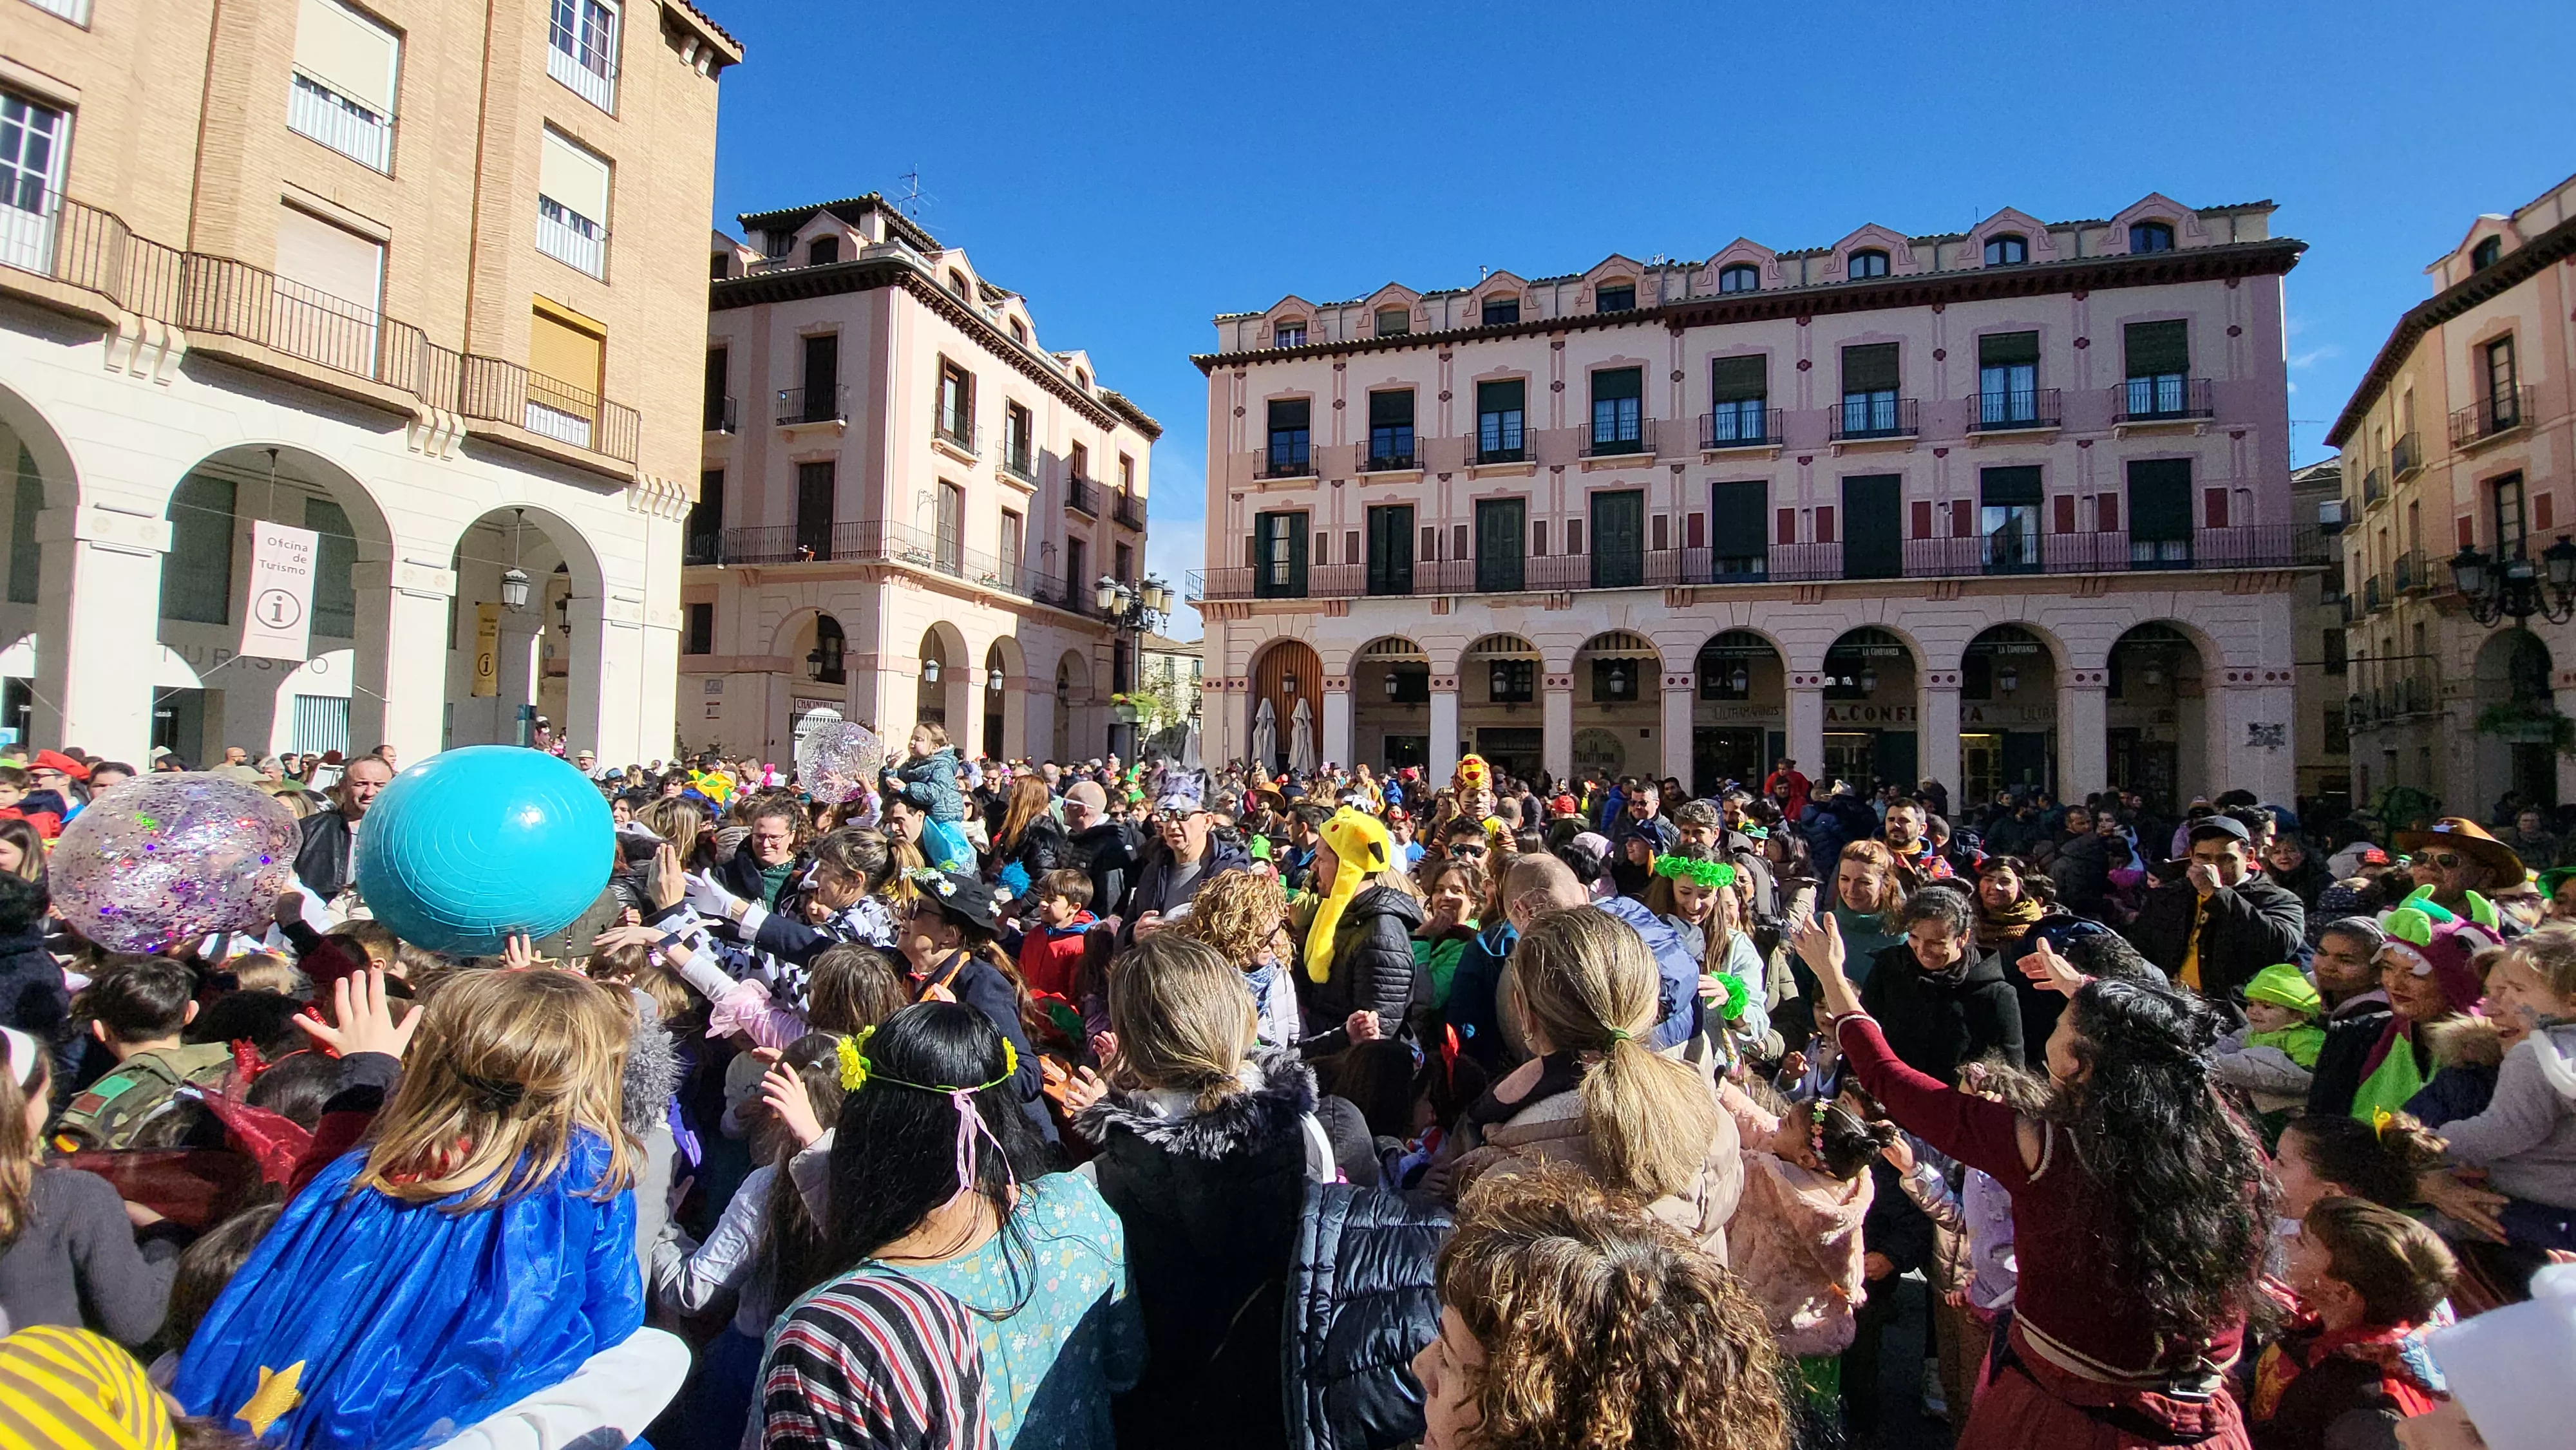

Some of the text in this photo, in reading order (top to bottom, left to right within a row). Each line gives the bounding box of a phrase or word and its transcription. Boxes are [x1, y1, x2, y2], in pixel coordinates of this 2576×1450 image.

[267, 537, 308, 552] Oficina
[292, 554, 307, 564] de
[259, 559, 306, 575] Turismo
